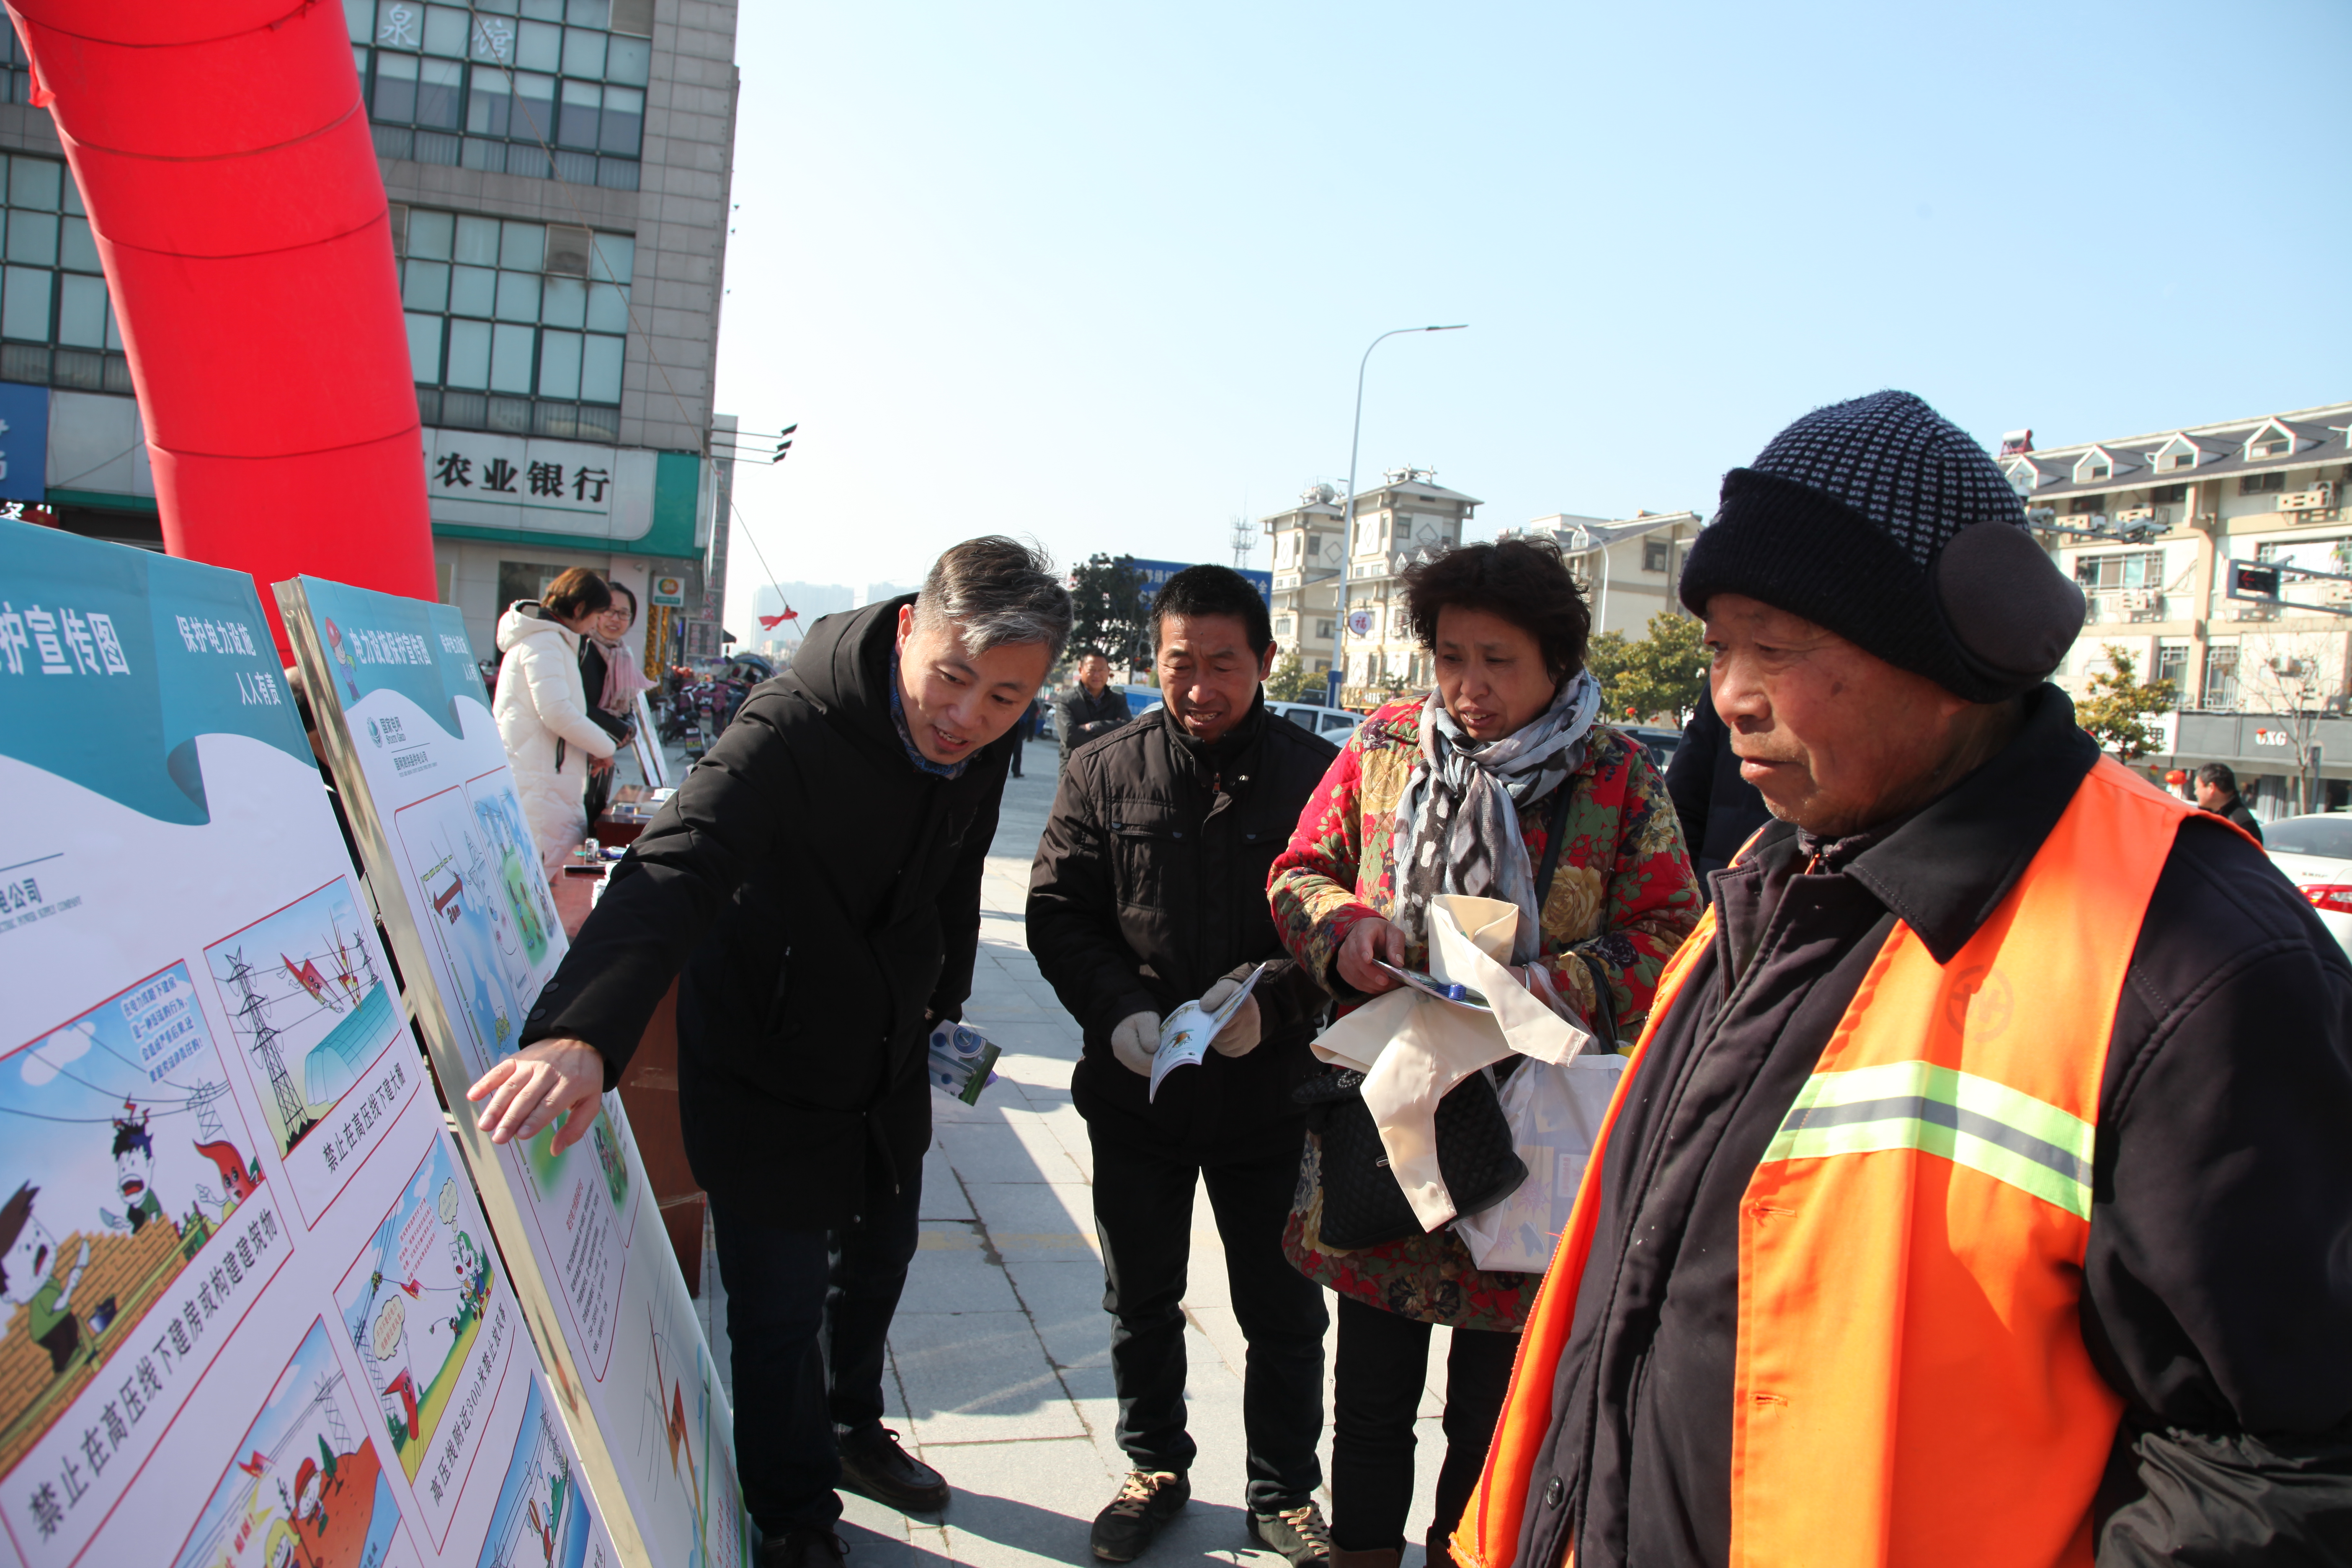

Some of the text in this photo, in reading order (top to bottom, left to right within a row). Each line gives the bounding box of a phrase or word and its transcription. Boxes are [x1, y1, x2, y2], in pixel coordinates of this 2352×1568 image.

[434, 452, 610, 502] 农业银行
[175, 615, 256, 656] 保护电力设施
[1355, 616, 1367, 629] 福
[349, 627, 432, 665] 电力设施保护宣传图
[236, 672, 281, 705] 人人有责
[379, 716, 402, 734] 国家电网
[322, 1062, 406, 1173] 禁止在高压线下建大棚
[28, 1207, 279, 1544] 禁止在高压线下建房或构建建筑物
[430, 1301, 506, 1507] 高压线附近300米禁止放风筝
